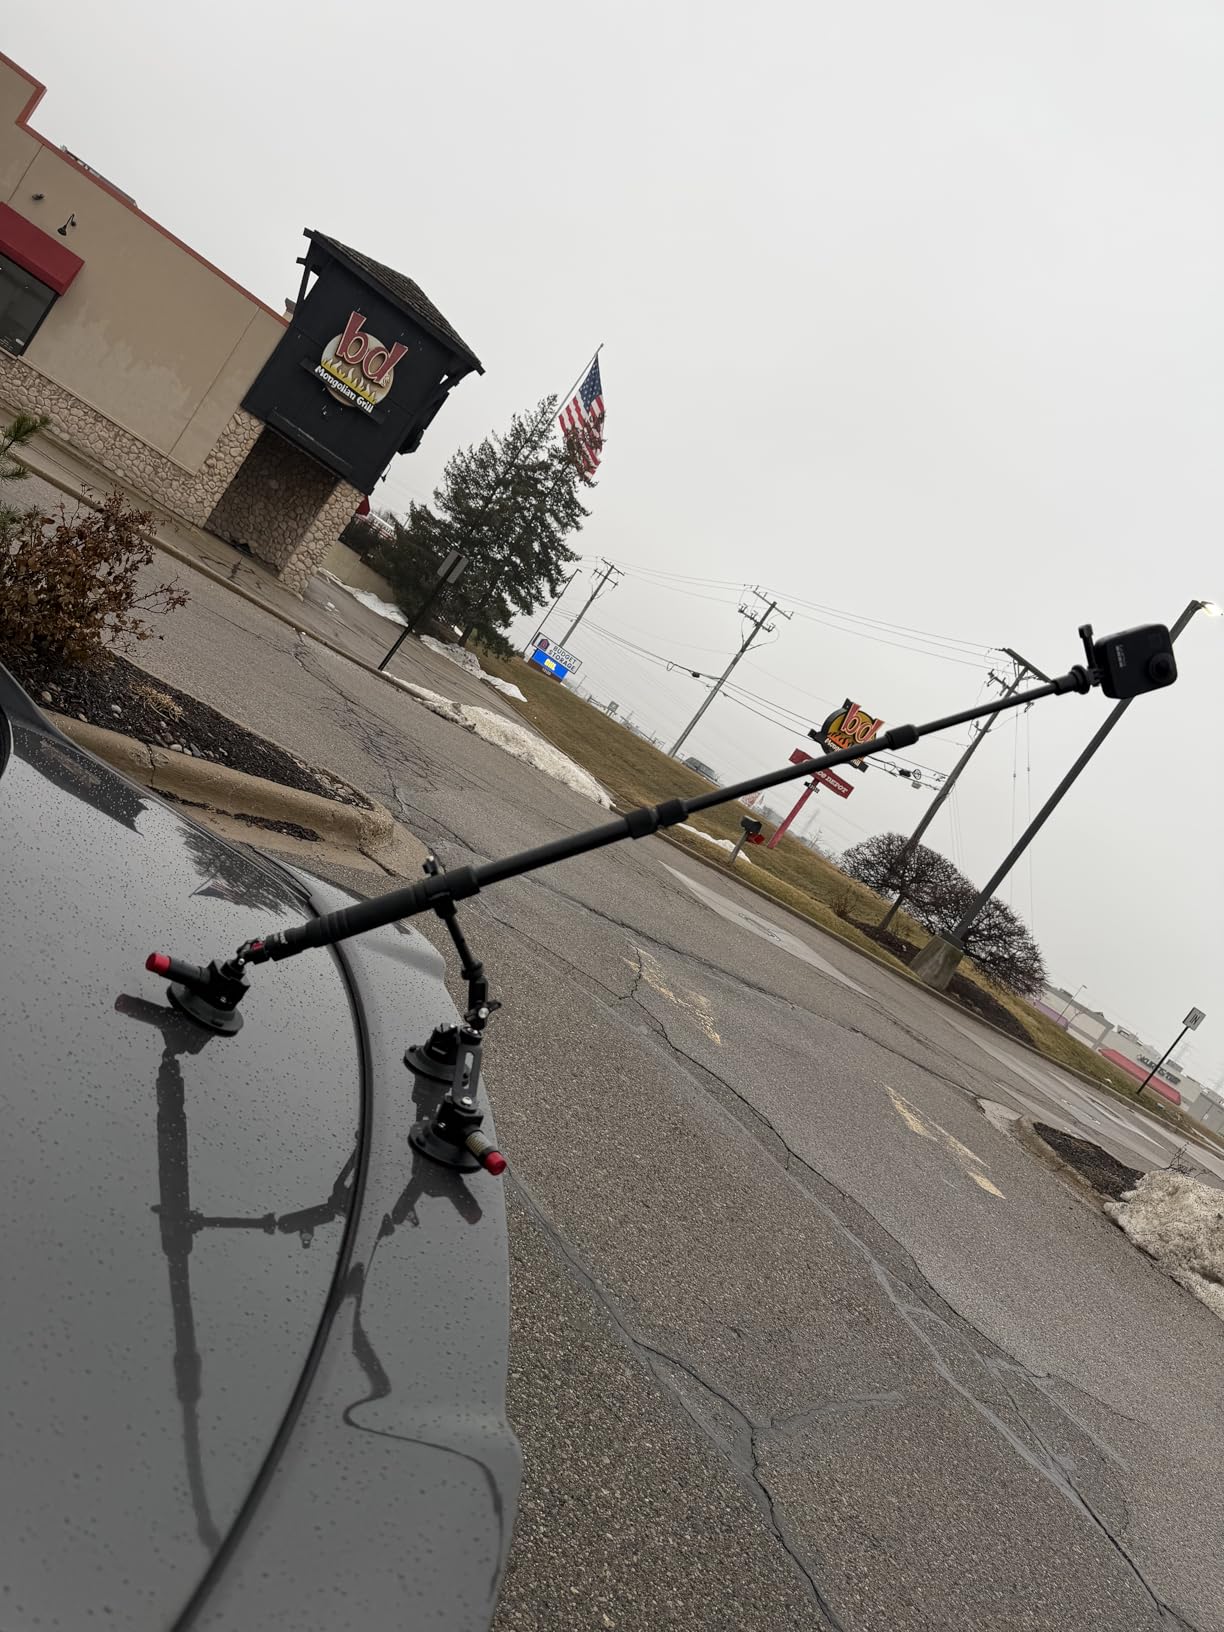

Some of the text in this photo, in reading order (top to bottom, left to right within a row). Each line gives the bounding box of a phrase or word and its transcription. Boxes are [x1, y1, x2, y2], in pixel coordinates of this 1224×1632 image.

[314, 365, 375, 414] Mongolian Grill
[548, 650, 576, 671] STORAGE
[553, 646, 577, 664] BUDGET
[824, 775, 849, 793] DEPOT
[1189, 1013, 1200, 1026] IN
